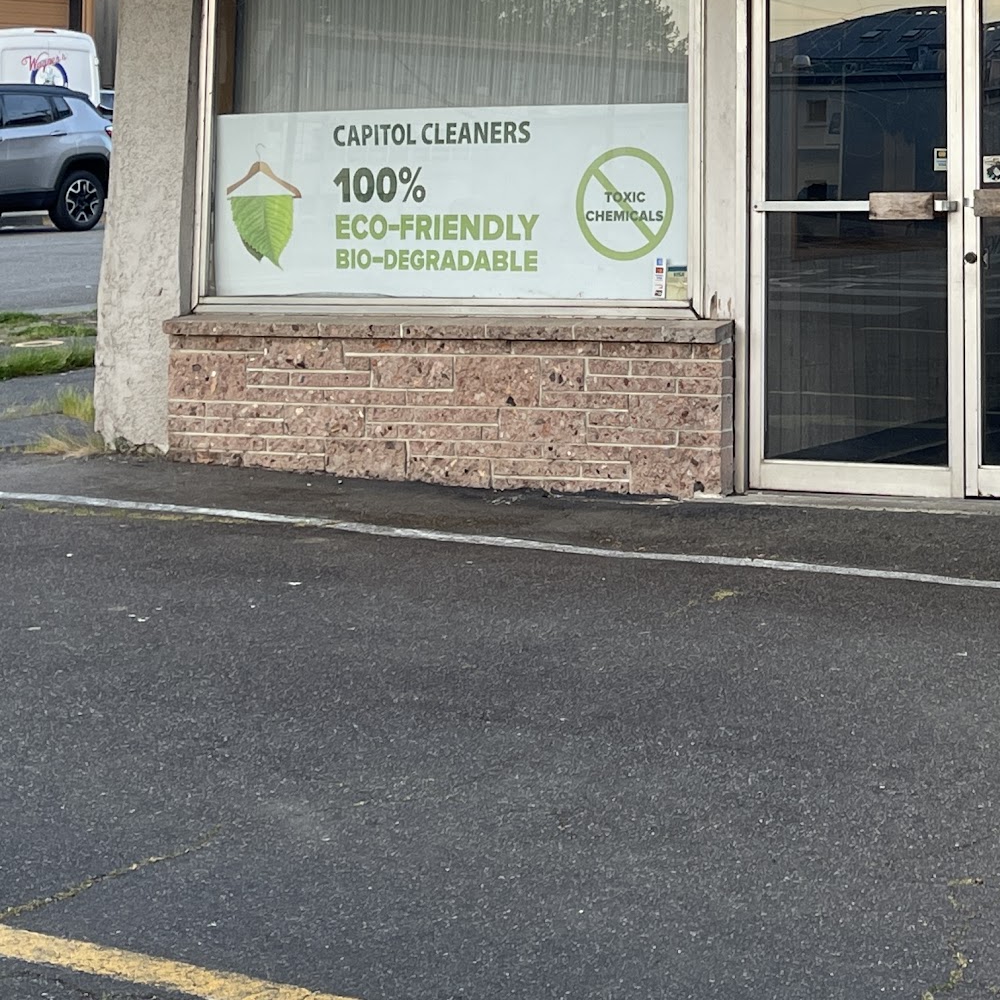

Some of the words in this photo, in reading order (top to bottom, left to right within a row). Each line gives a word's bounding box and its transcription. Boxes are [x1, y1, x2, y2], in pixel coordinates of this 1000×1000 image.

[333, 123, 417, 147] CAPITOL
[421, 121, 532, 145] CLEANERS
[333, 166, 427, 203] 100%
[604, 191, 647, 203] TOXIC
[335, 213, 540, 241] ECO-FRIENDLY
[585, 210, 665, 222] CHEMICALS
[335, 248, 539, 272] BIO-DEGRADABLE
